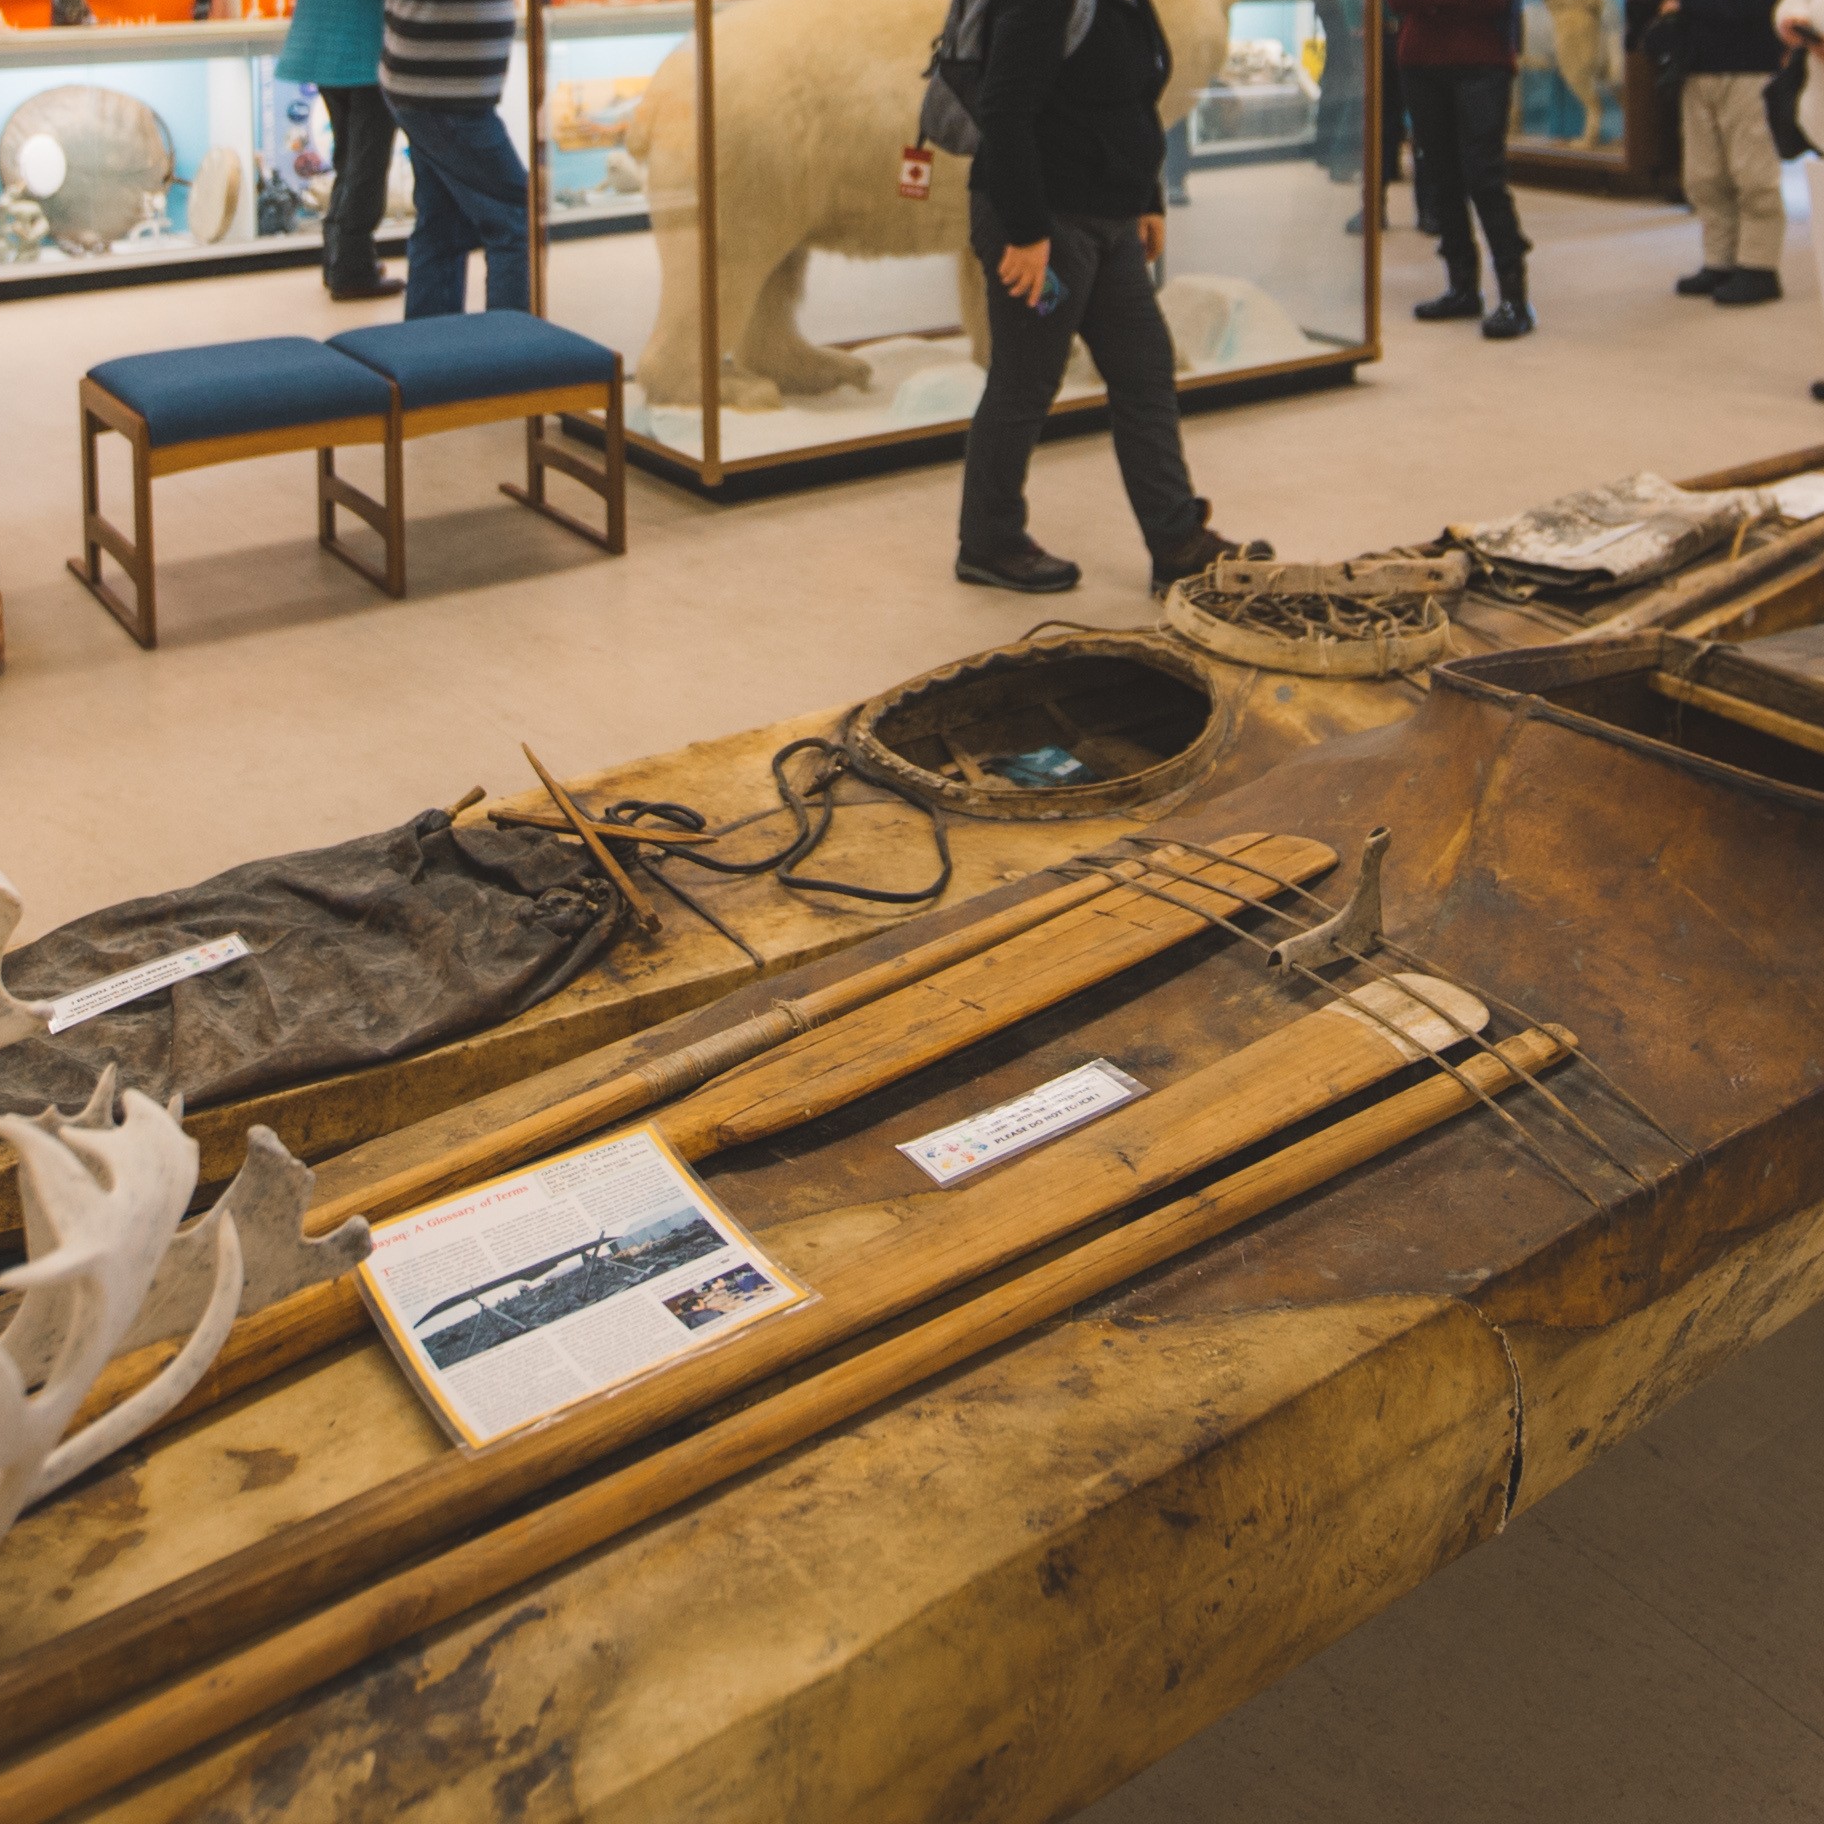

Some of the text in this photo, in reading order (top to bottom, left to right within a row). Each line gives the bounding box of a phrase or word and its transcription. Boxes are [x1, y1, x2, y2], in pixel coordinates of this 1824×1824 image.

[995, 1125, 1028, 1145] PLEASE
[1030, 1119, 1045, 1130] DO
[1044, 1109, 1064, 1123] NOT
[415, 1224, 424, 1234] A
[427, 1204, 476, 1229] Glossary
[480, 1194, 493, 1208] of
[494, 1184, 530, 1203] Terms
